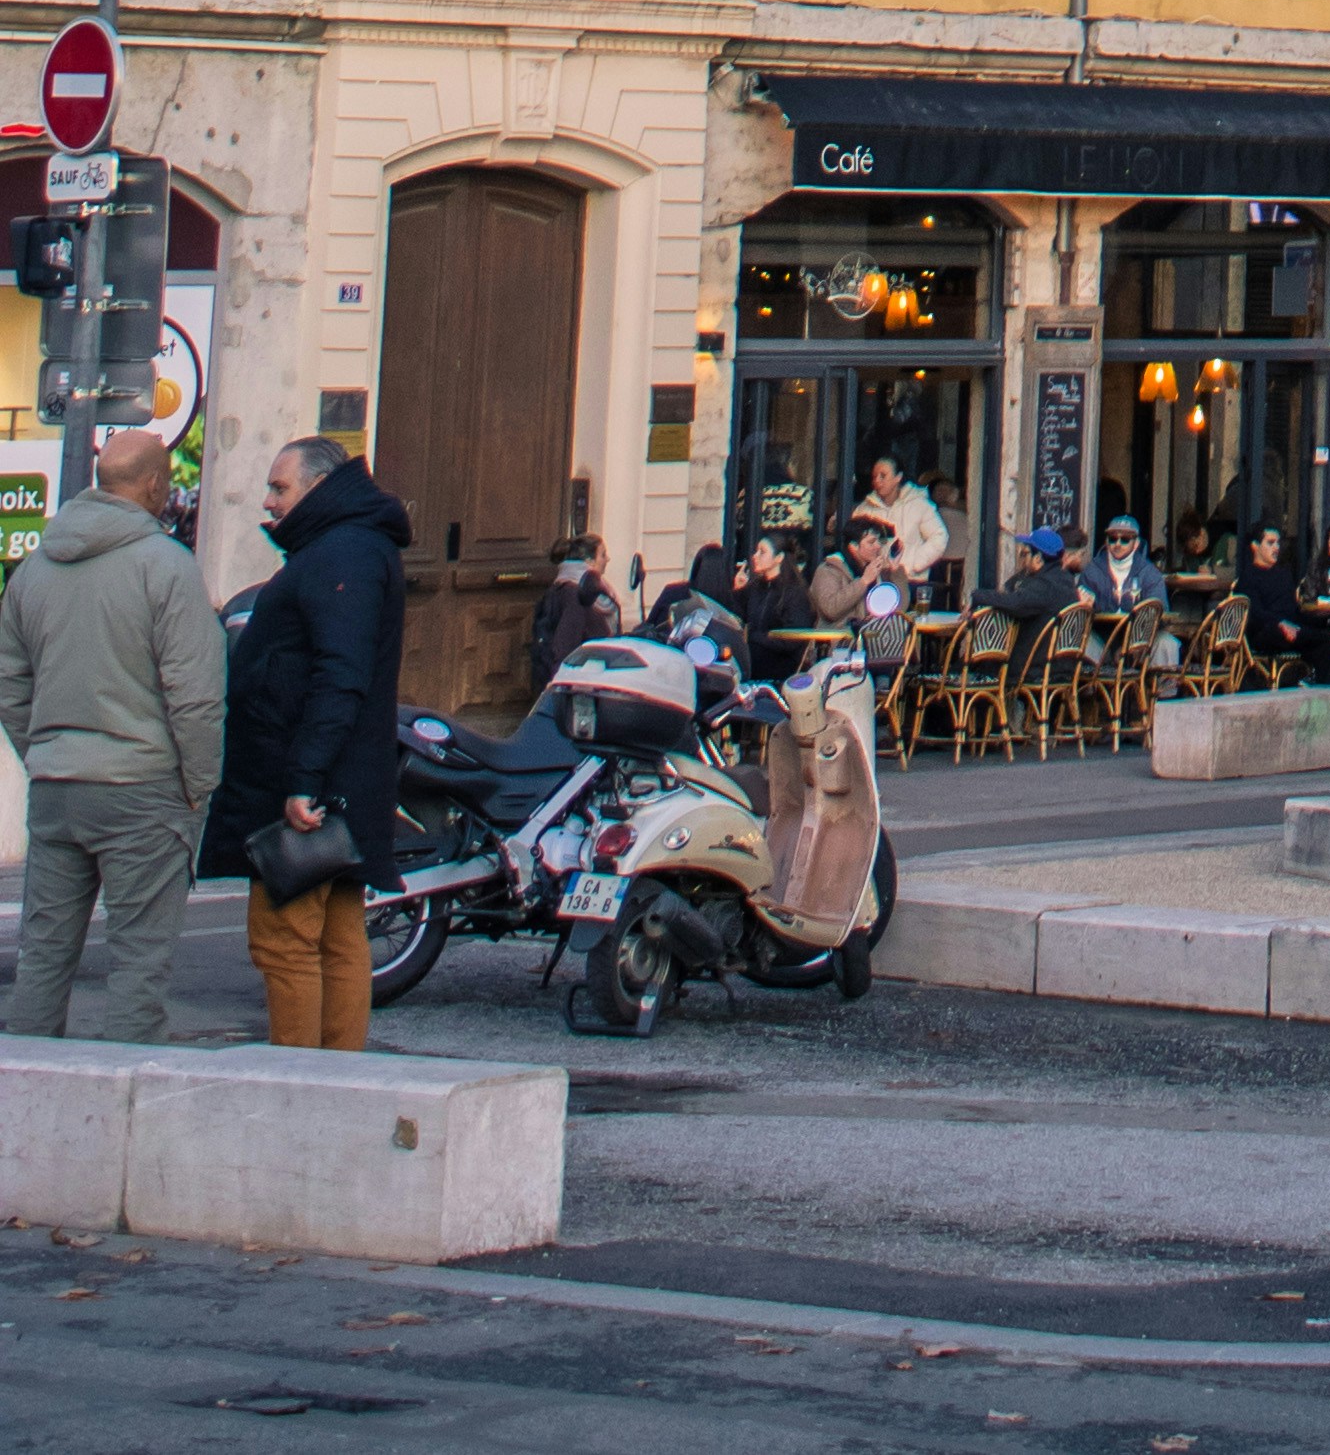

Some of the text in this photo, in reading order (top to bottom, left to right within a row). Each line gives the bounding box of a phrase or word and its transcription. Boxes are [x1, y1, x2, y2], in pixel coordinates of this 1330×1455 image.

[821, 143, 874, 173] Café
[50, 169, 79, 186] SAUF
[343, 285, 360, 300] 39
[0, 485, 44, 510] oix.
